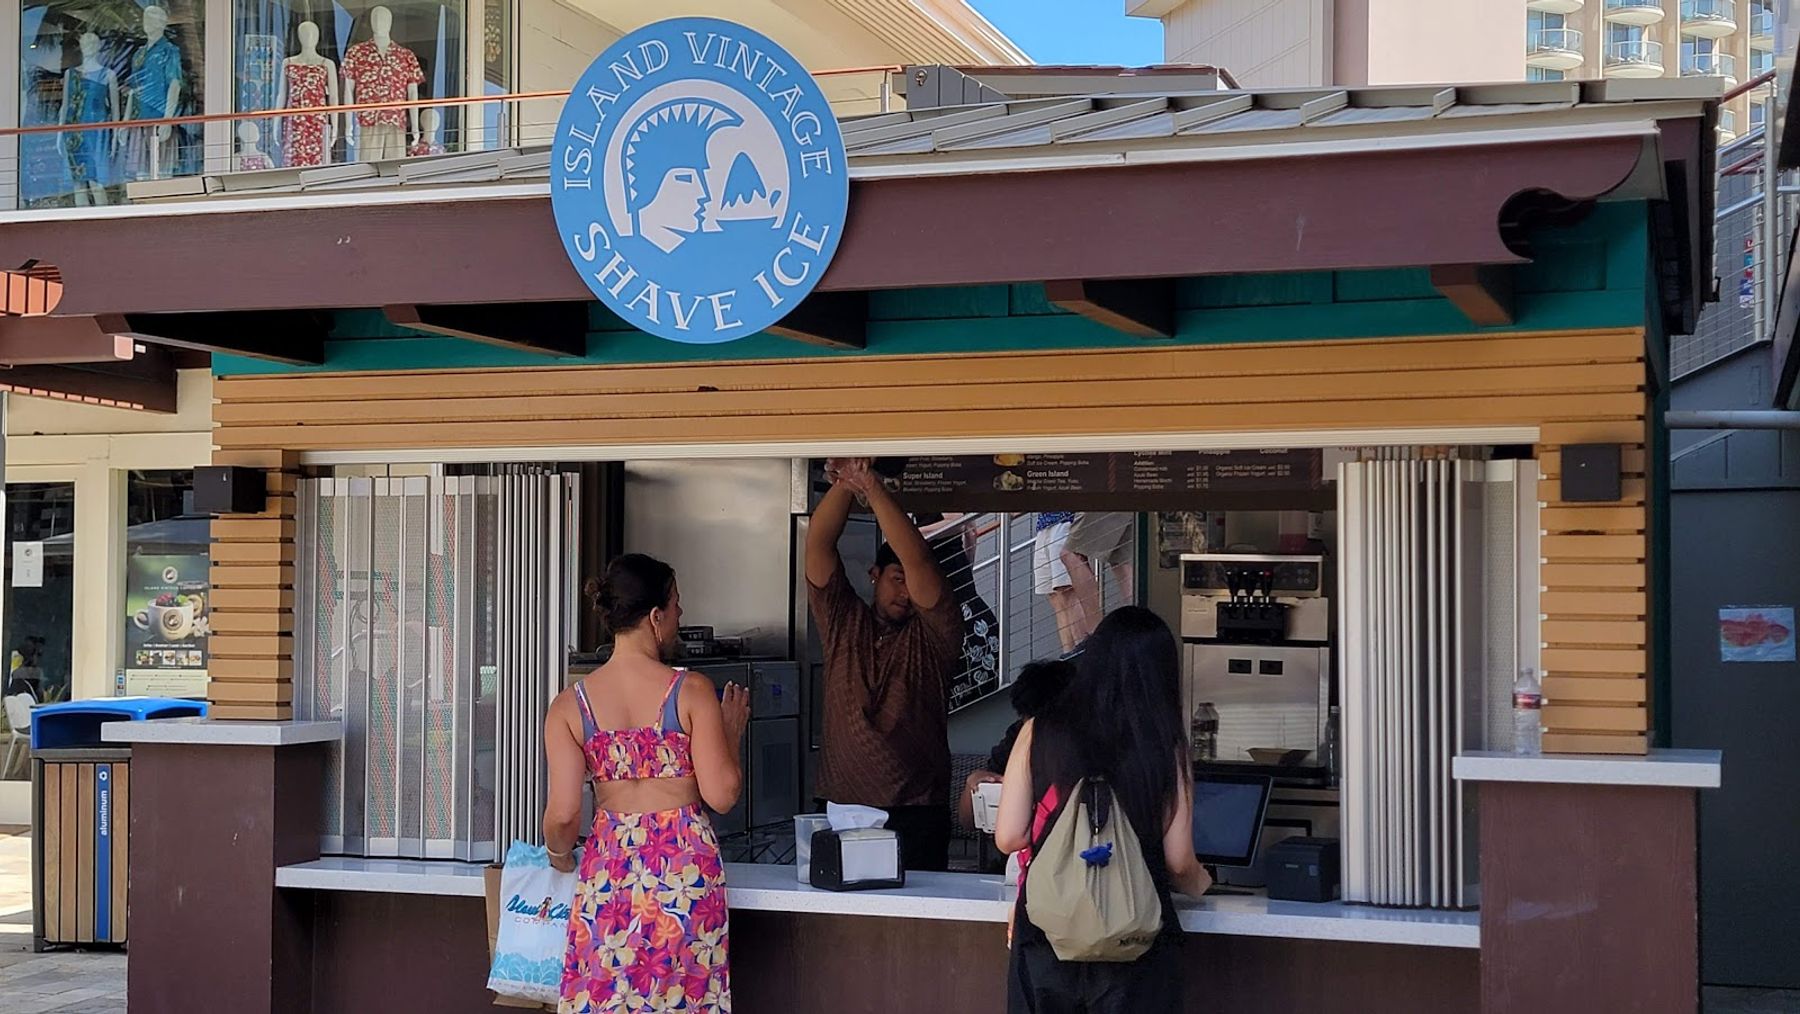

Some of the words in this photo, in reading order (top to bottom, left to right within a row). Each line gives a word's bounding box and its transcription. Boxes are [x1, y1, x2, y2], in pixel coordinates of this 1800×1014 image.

[563, 39, 669, 190] ISLAND
[683, 31, 832, 179] VINTAGE
[574, 222, 743, 331] SHAVE
[753, 212, 830, 309] ICE
[903, 472, 922, 480] Super
[923, 471, 943, 480] Island
[1026, 470, 1047, 478] Green
[1048, 470, 1069, 478] Island
[99, 790, 108, 836] aluminum
